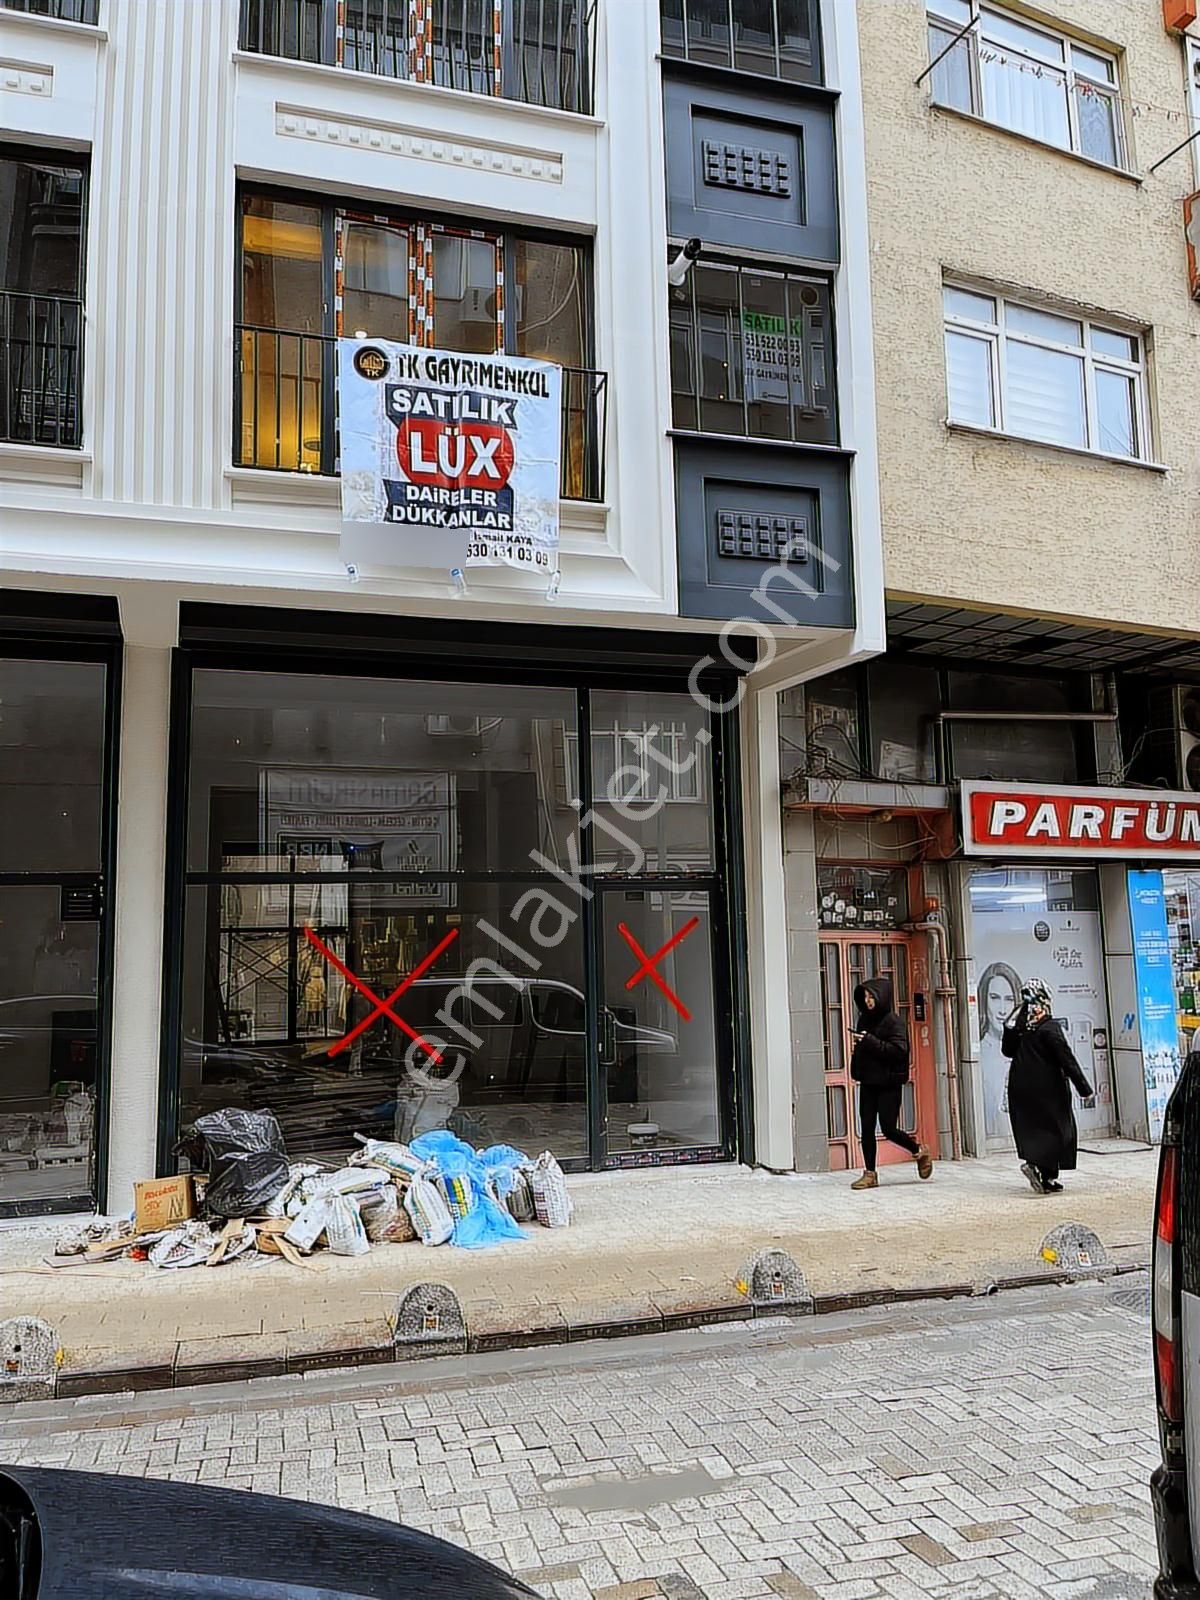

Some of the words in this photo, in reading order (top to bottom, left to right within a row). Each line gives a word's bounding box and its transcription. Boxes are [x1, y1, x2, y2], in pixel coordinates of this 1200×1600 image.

[744, 314, 800, 335] SATILK
[392, 389, 514, 424] SATILIK
[410, 427, 502, 479] LÜX
[392, 504, 512, 529] DÜKKANLAR
[506, 535, 532, 546] KAYA
[518, 547, 532, 562] 03
